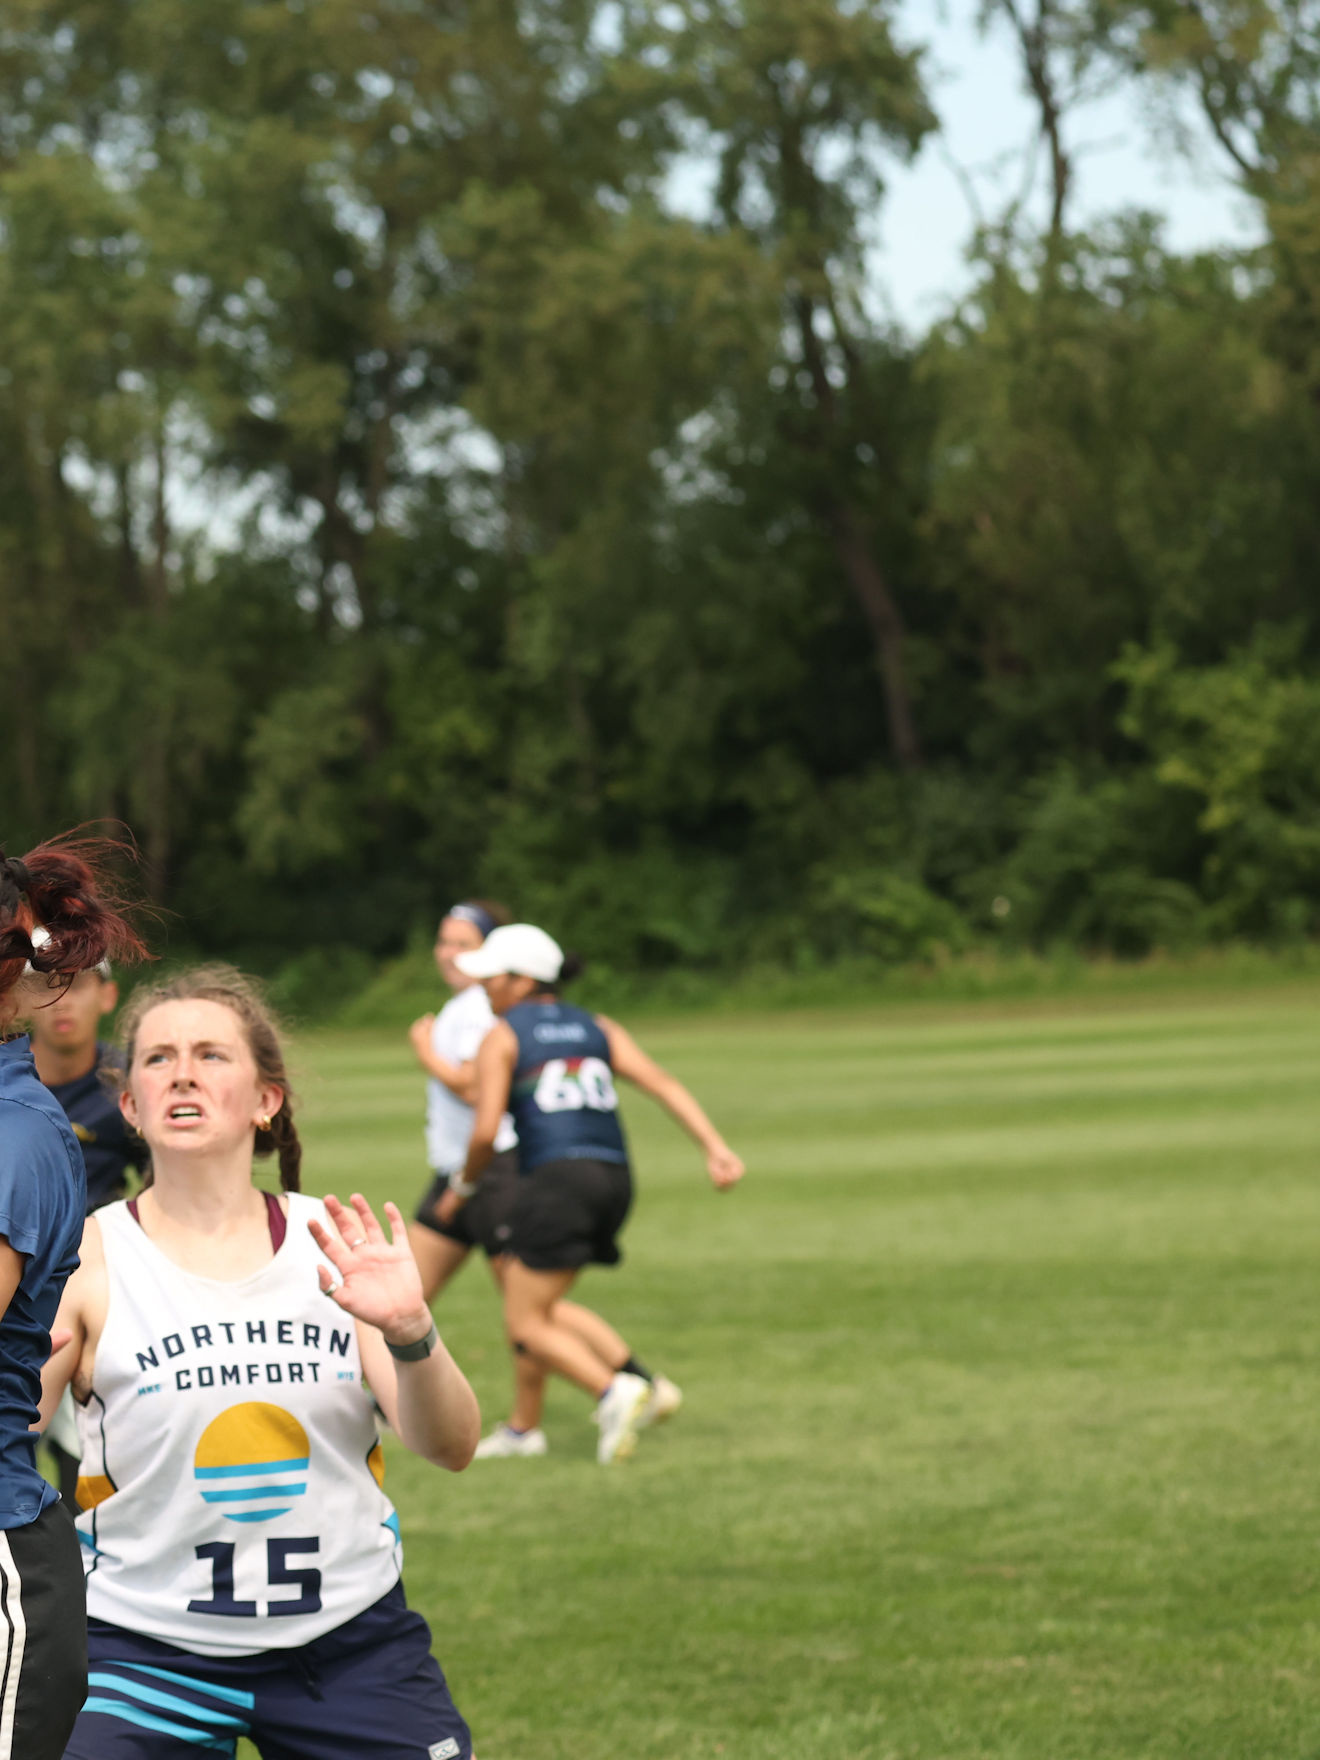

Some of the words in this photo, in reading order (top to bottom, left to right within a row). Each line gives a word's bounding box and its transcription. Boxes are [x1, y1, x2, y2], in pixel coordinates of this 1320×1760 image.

[136, 1321, 351, 1371] NORTHERN
[176, 1362, 321, 1391] COMFORT
[186, 1536, 323, 1618] 15
